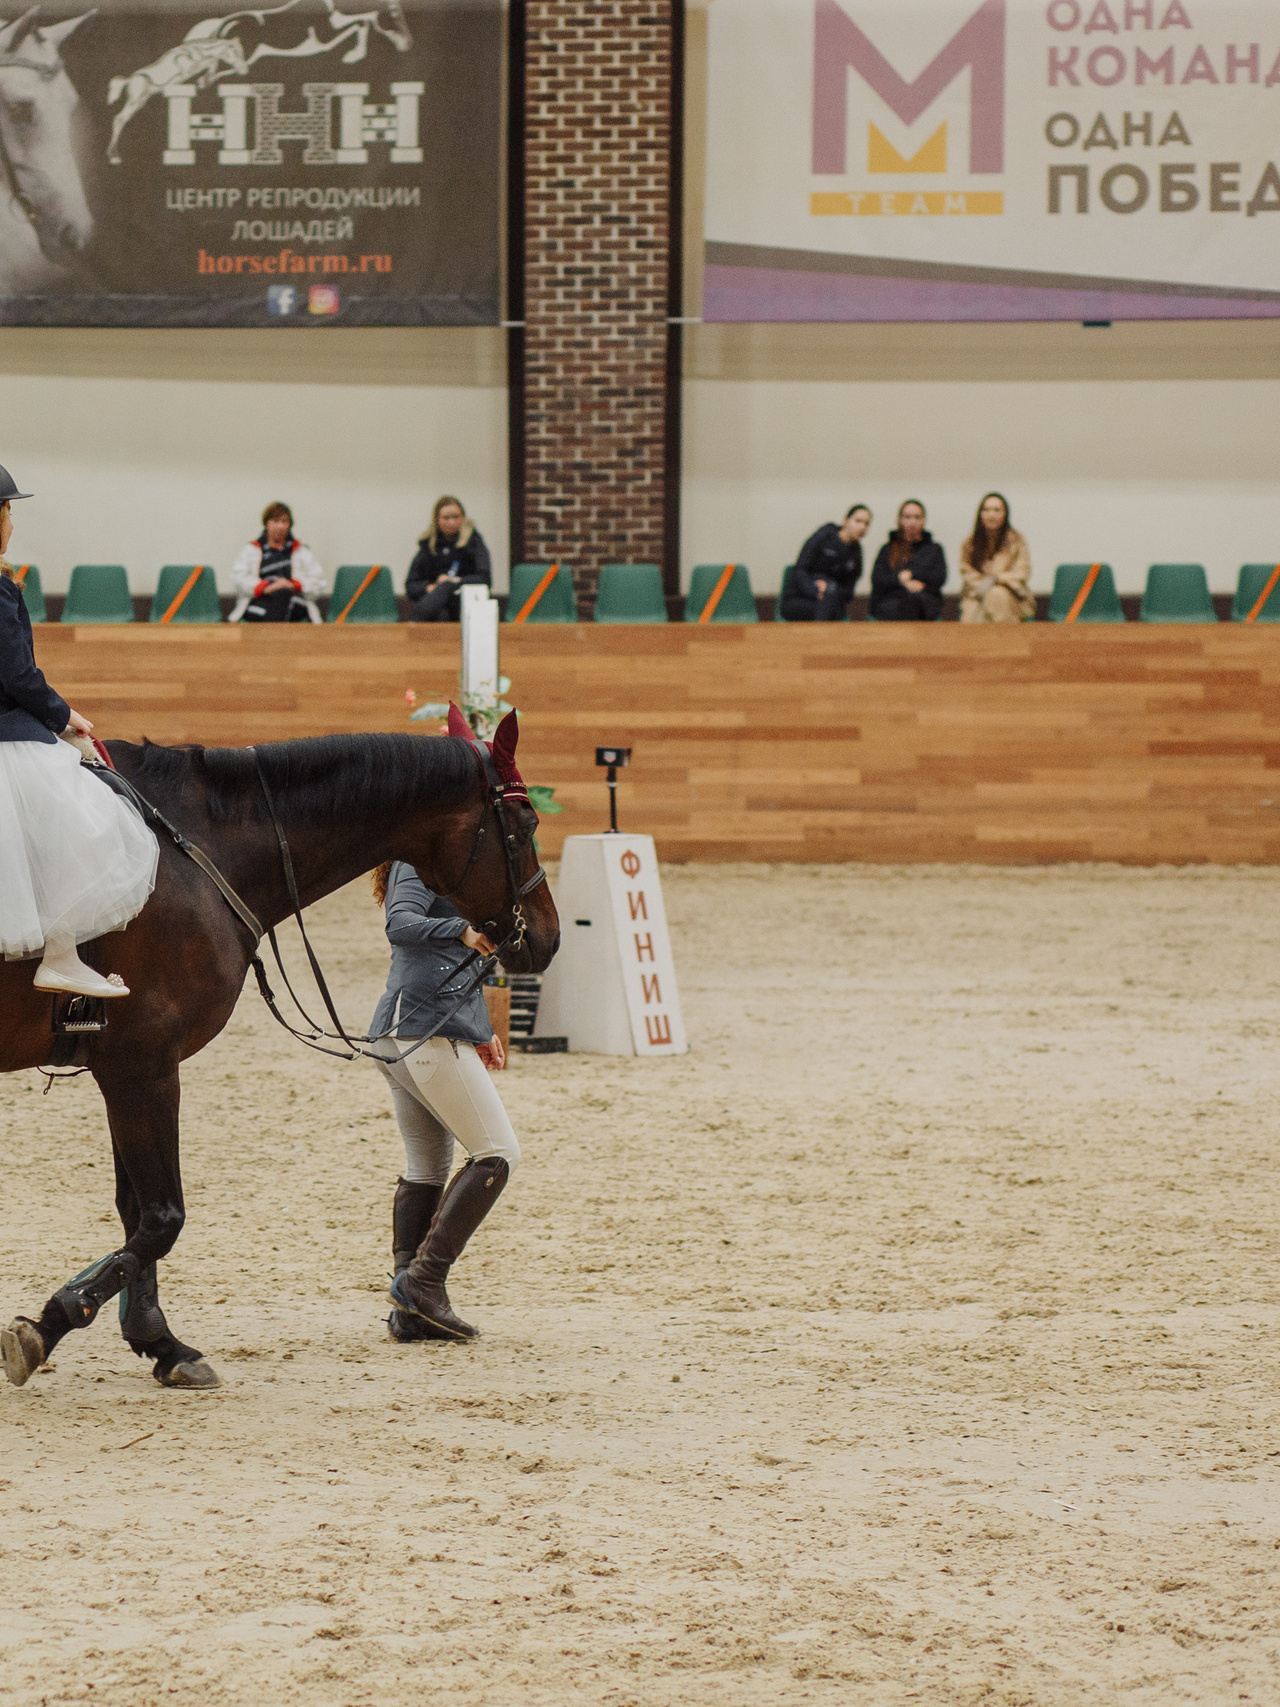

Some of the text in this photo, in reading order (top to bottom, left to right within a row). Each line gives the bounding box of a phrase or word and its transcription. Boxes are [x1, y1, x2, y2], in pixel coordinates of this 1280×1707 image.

[1045, 0, 1193, 35] ОДНА
[1044, 110, 1193, 151] ОДНА
[166, 186, 420, 212] ЦЕНТР РЕПРОДУКЦИИ
[845, 191, 967, 216] TEAM
[230, 215, 354, 244] ЛОШАДЕЙ
[198, 249, 393, 274] horsefarm.ru
[620, 849, 672, 1046] ФИНИШ
